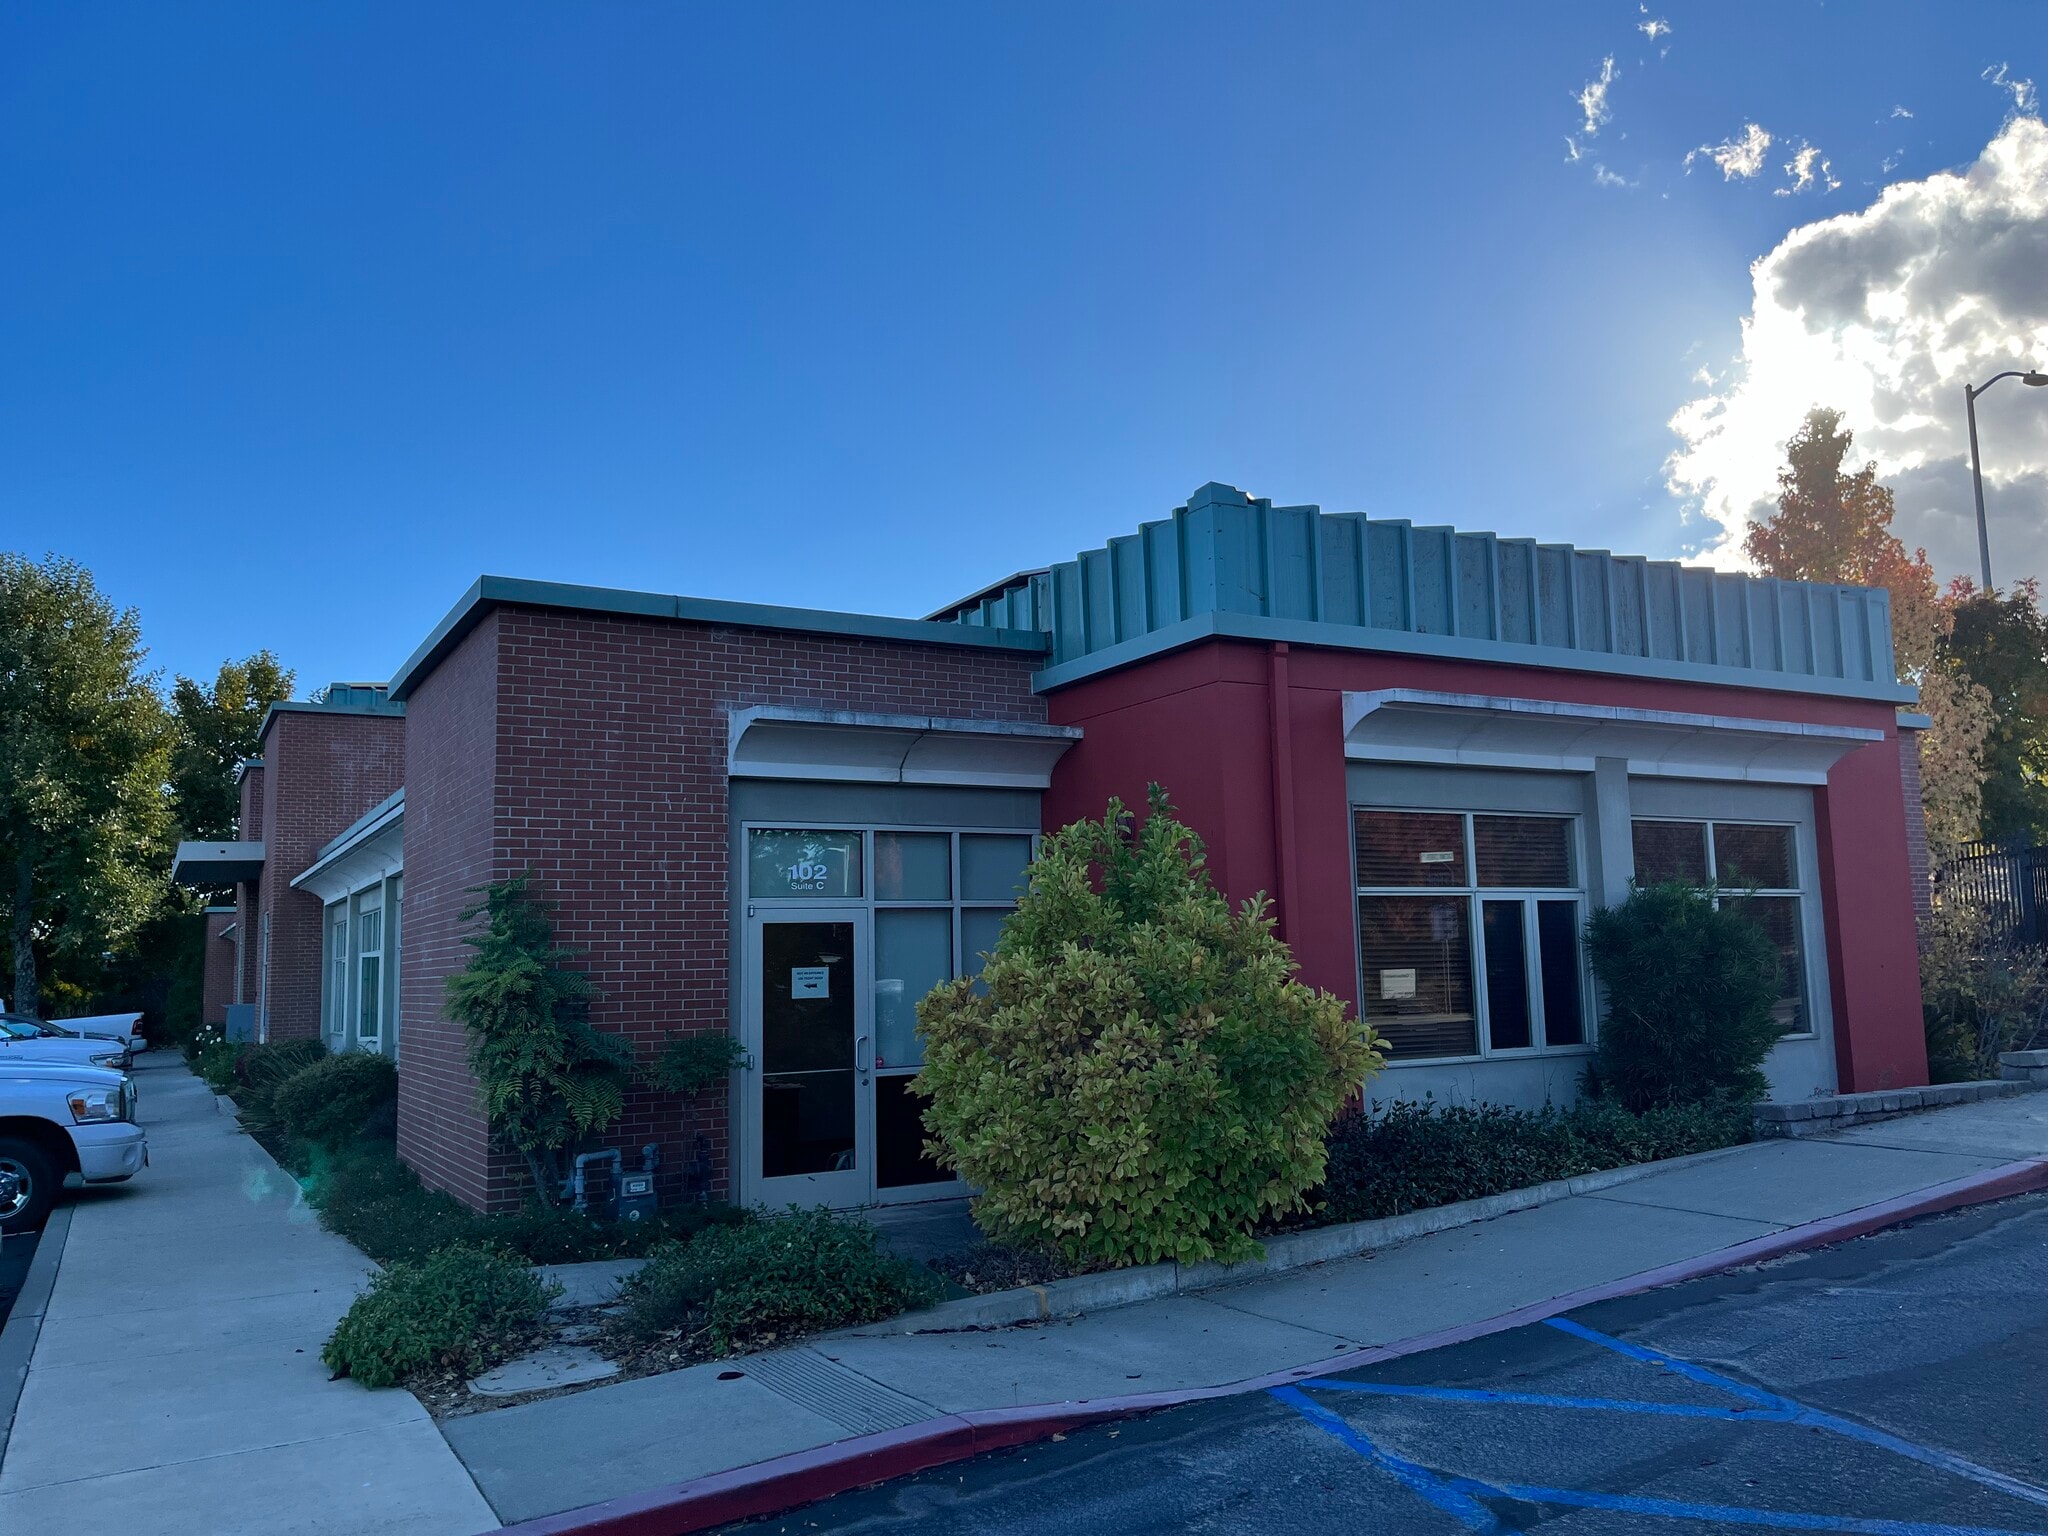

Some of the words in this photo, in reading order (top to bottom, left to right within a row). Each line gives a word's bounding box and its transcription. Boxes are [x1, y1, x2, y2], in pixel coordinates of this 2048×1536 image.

[787, 864, 827, 880] 102
[791, 882, 813, 890] Suite
[816, 881, 824, 890] C
